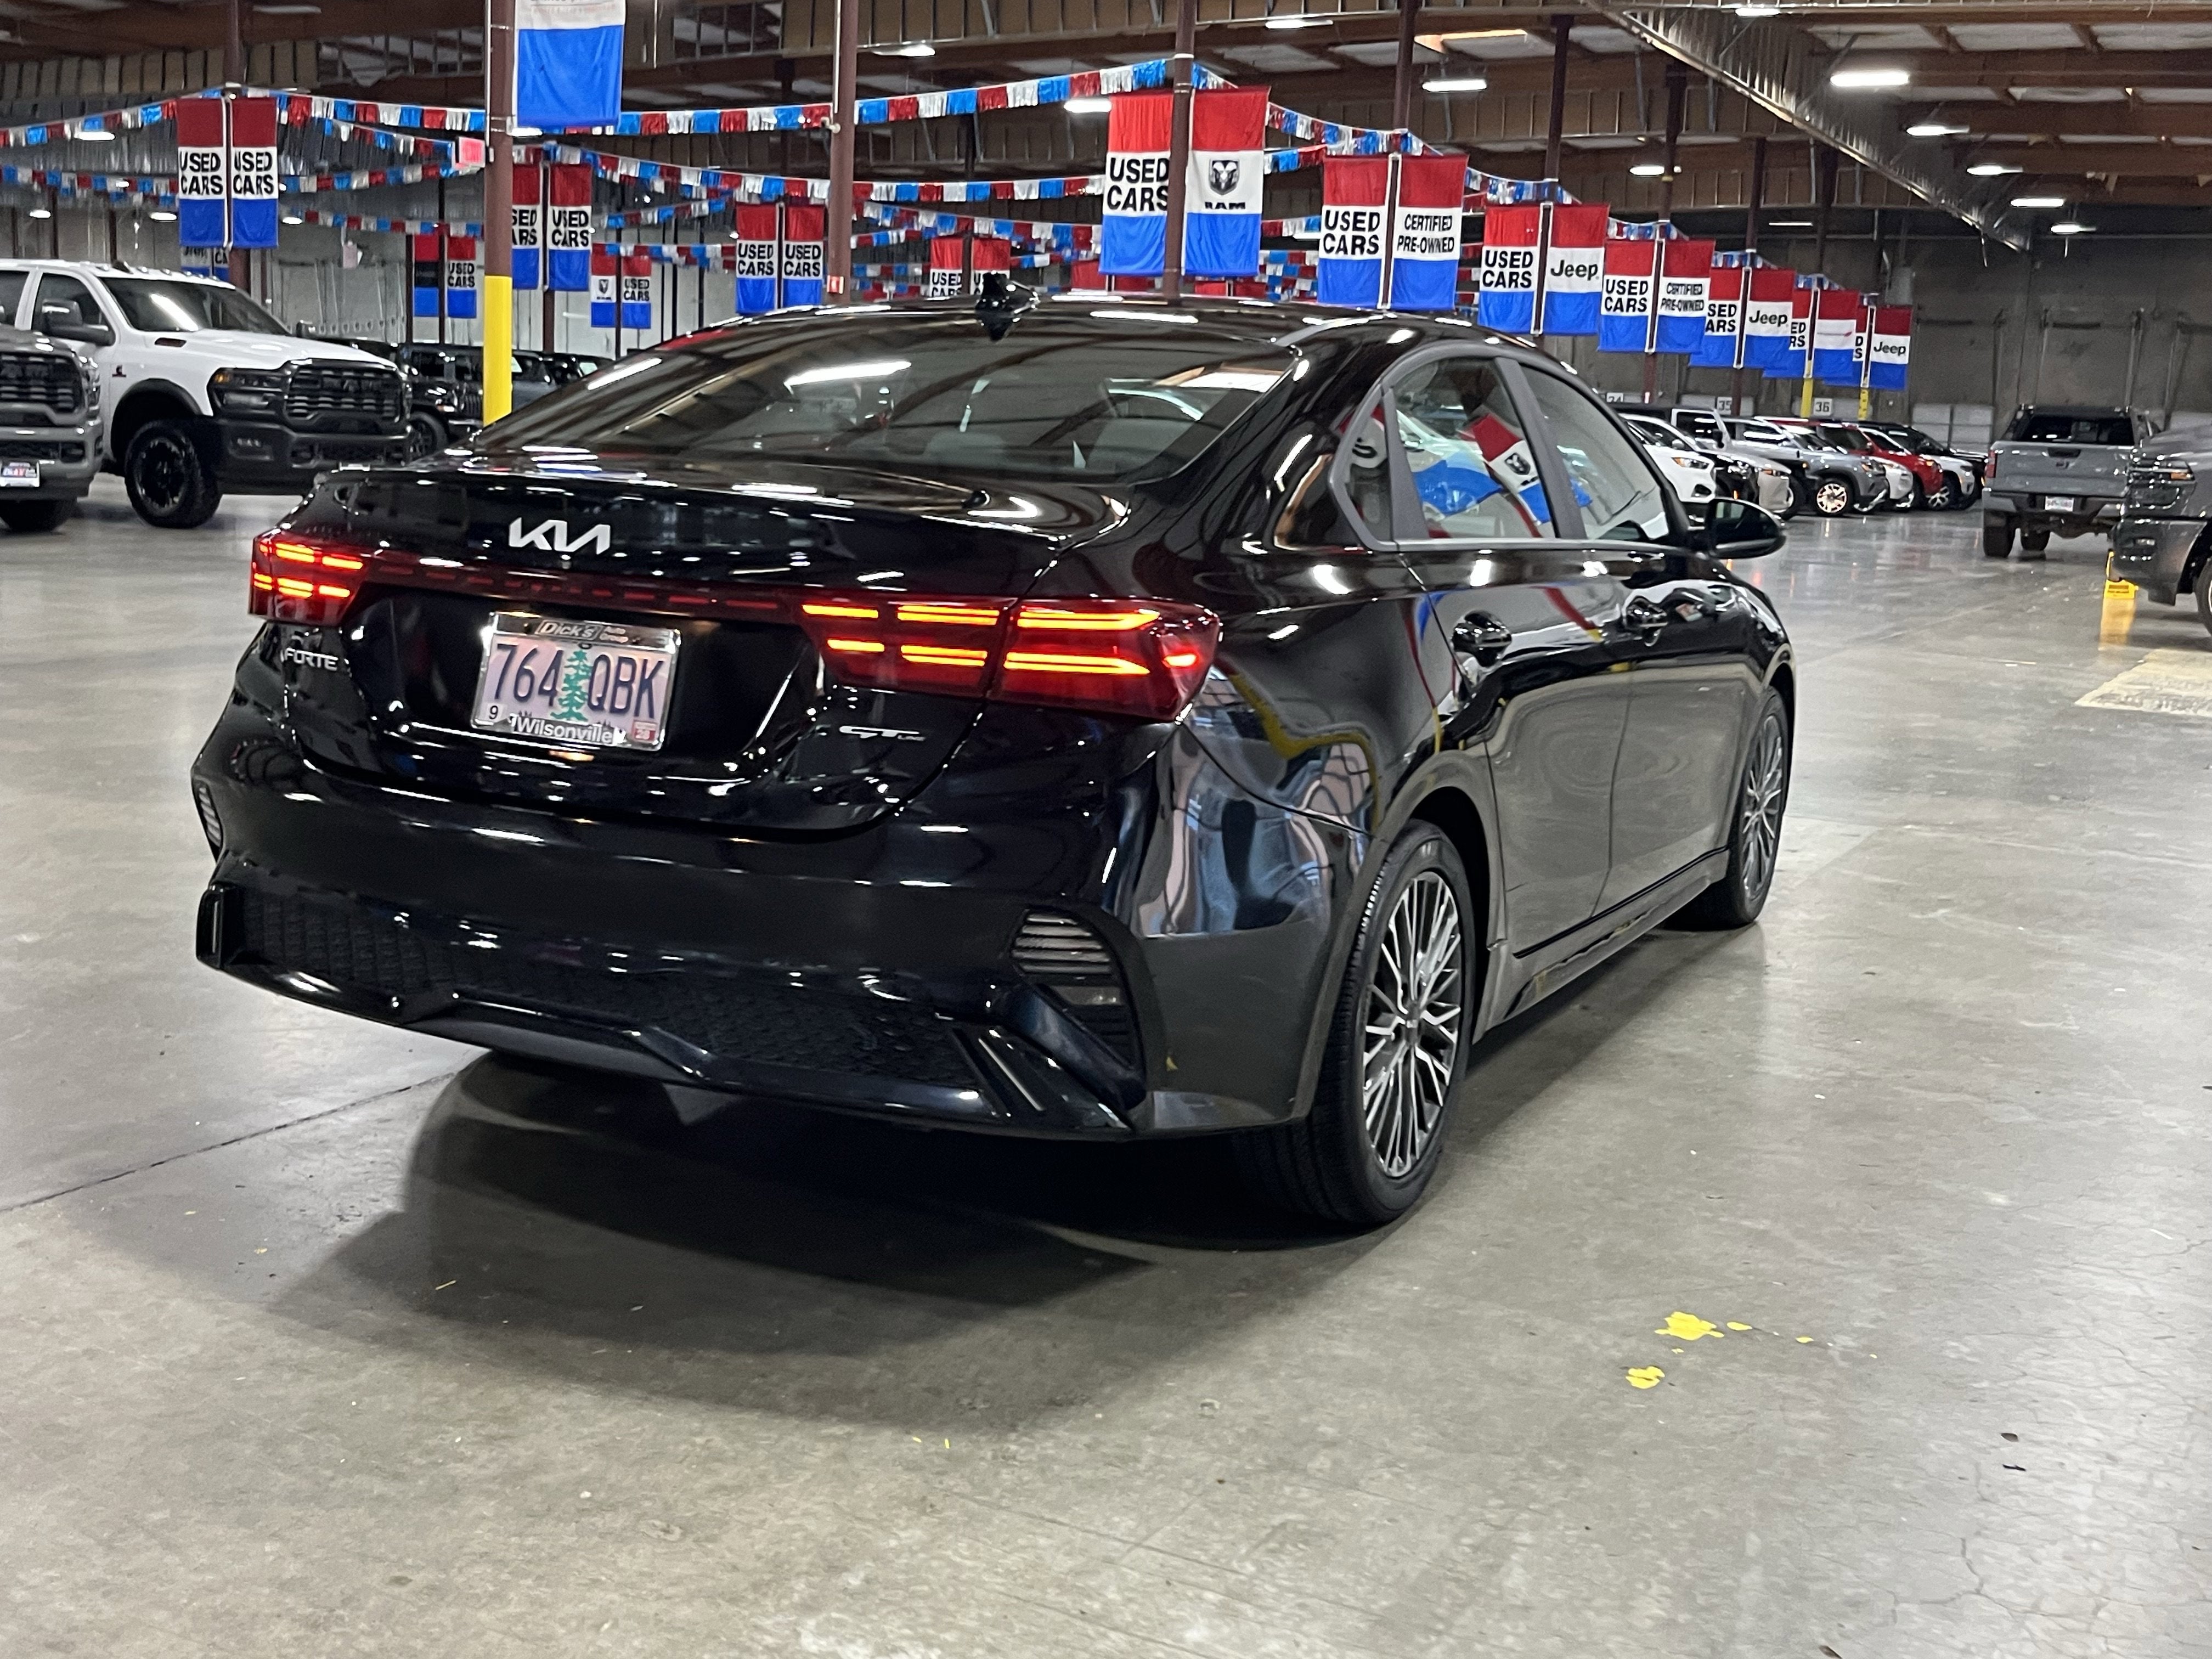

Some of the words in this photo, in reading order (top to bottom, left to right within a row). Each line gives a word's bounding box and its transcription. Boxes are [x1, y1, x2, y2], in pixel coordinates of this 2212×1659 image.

[179, 151, 221, 172] USED
[234, 151, 273, 172] USED
[1110, 157, 1169, 183] USED
[180, 174, 223, 195] CARS
[233, 173, 274, 195] CARS
[1107, 185, 1168, 211] CARS
[512, 209, 537, 226] SED
[552, 209, 589, 228] USED
[1324, 210, 1380, 232] USED
[1404, 214, 1453, 231] CERTIFIED
[512, 228, 537, 245] RS
[551, 229, 589, 247] CARS
[1323, 233, 1380, 255] CARS
[1397, 235, 1454, 253] PRE-OWNED
[738, 243, 774, 259] USED
[785, 244, 821, 260] USED
[1484, 250, 1533, 268] USED
[448, 263, 475, 274] USED
[738, 260, 774, 275] CARS
[784, 261, 821, 276] CARS
[1550, 259, 1599, 281] Jeep
[448, 276, 475, 287] CARS
[624, 278, 650, 289] USED
[1482, 269, 1532, 288] CARS
[1605, 279, 1649, 295] USED
[624, 290, 650, 301] CARS
[1605, 296, 1647, 312] CARS
[1707, 303, 1737, 317] SED
[1705, 319, 1736, 332] ARS
[1749, 310, 1788, 328] Jeep
[1791, 322, 1806, 334] ED
[1874, 342, 1906, 356] Jeep
[1718, 400, 1731, 411] 35
[1815, 402, 1830, 412] 36
[508, 517, 611, 555] KIA
[540, 622, 594, 638] Dick's
[284, 647, 338, 671] FORTE
[495, 643, 563, 707] 764
[587, 654, 664, 719] QBK
[489, 705, 499, 719] 9
[517, 718, 613, 743] Wilsonville
